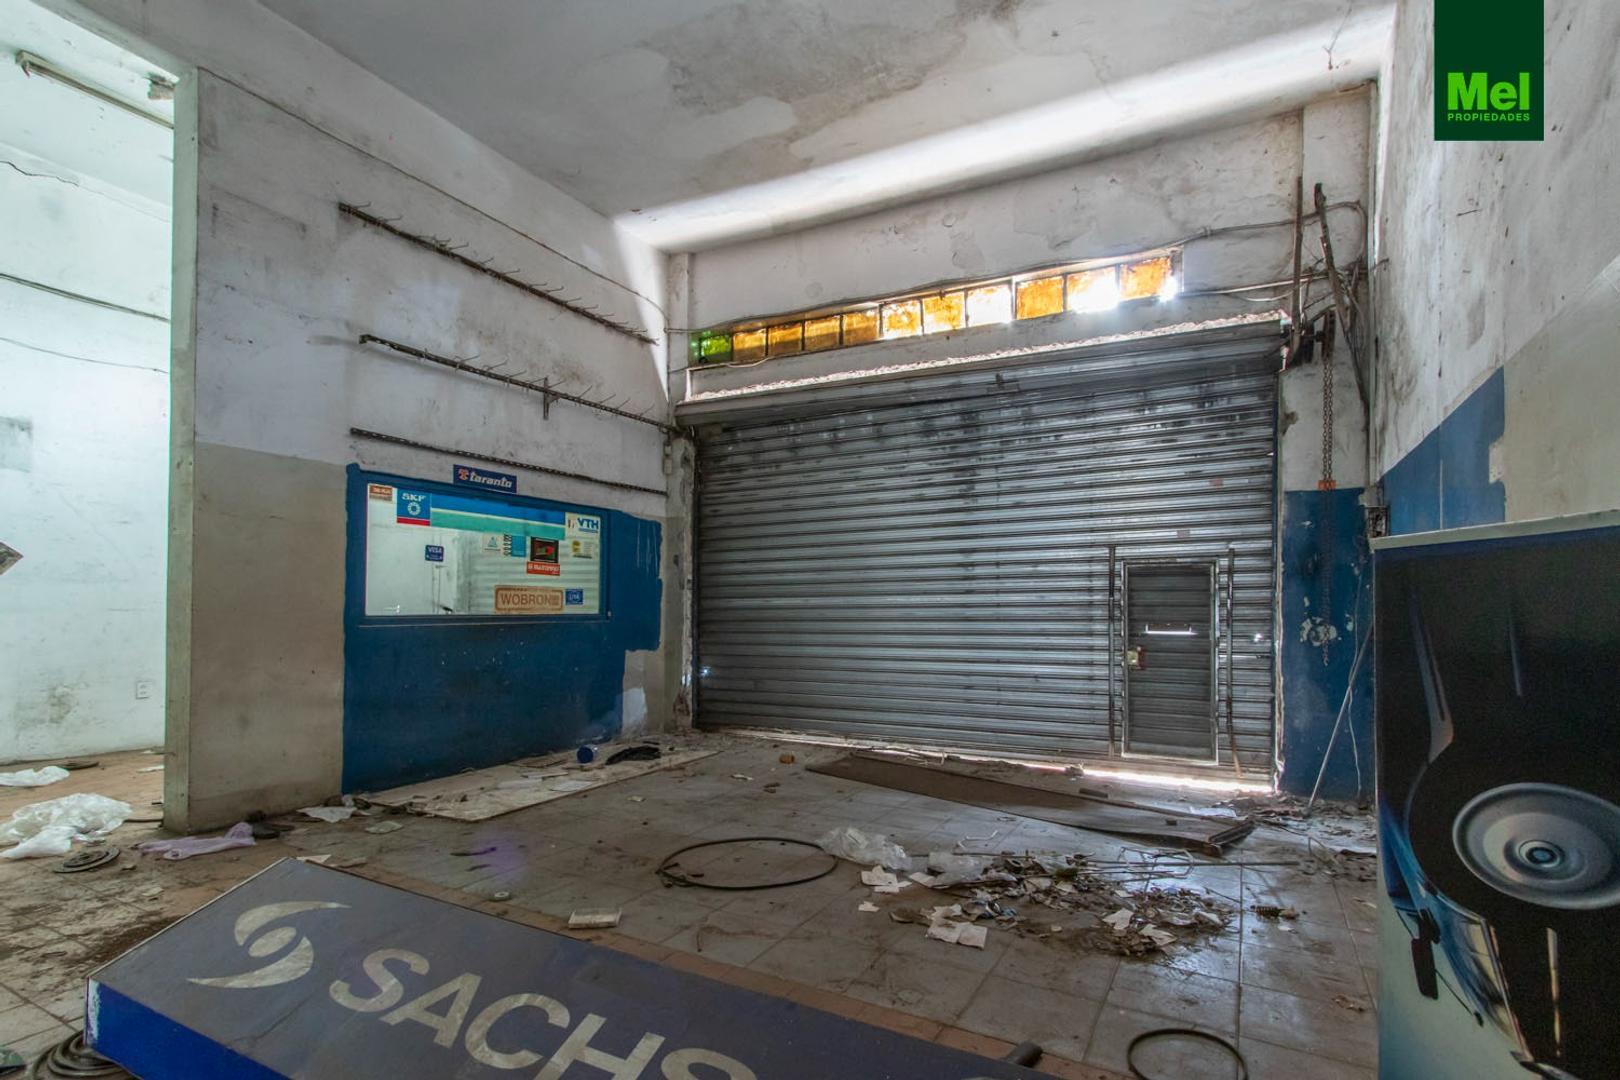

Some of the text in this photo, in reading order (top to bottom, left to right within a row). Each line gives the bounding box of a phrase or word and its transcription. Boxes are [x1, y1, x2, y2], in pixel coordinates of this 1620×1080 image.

[401, 492, 426, 502] SKF
[577, 517, 599, 530] VTH
[501, 592, 551, 606] WOBRON
